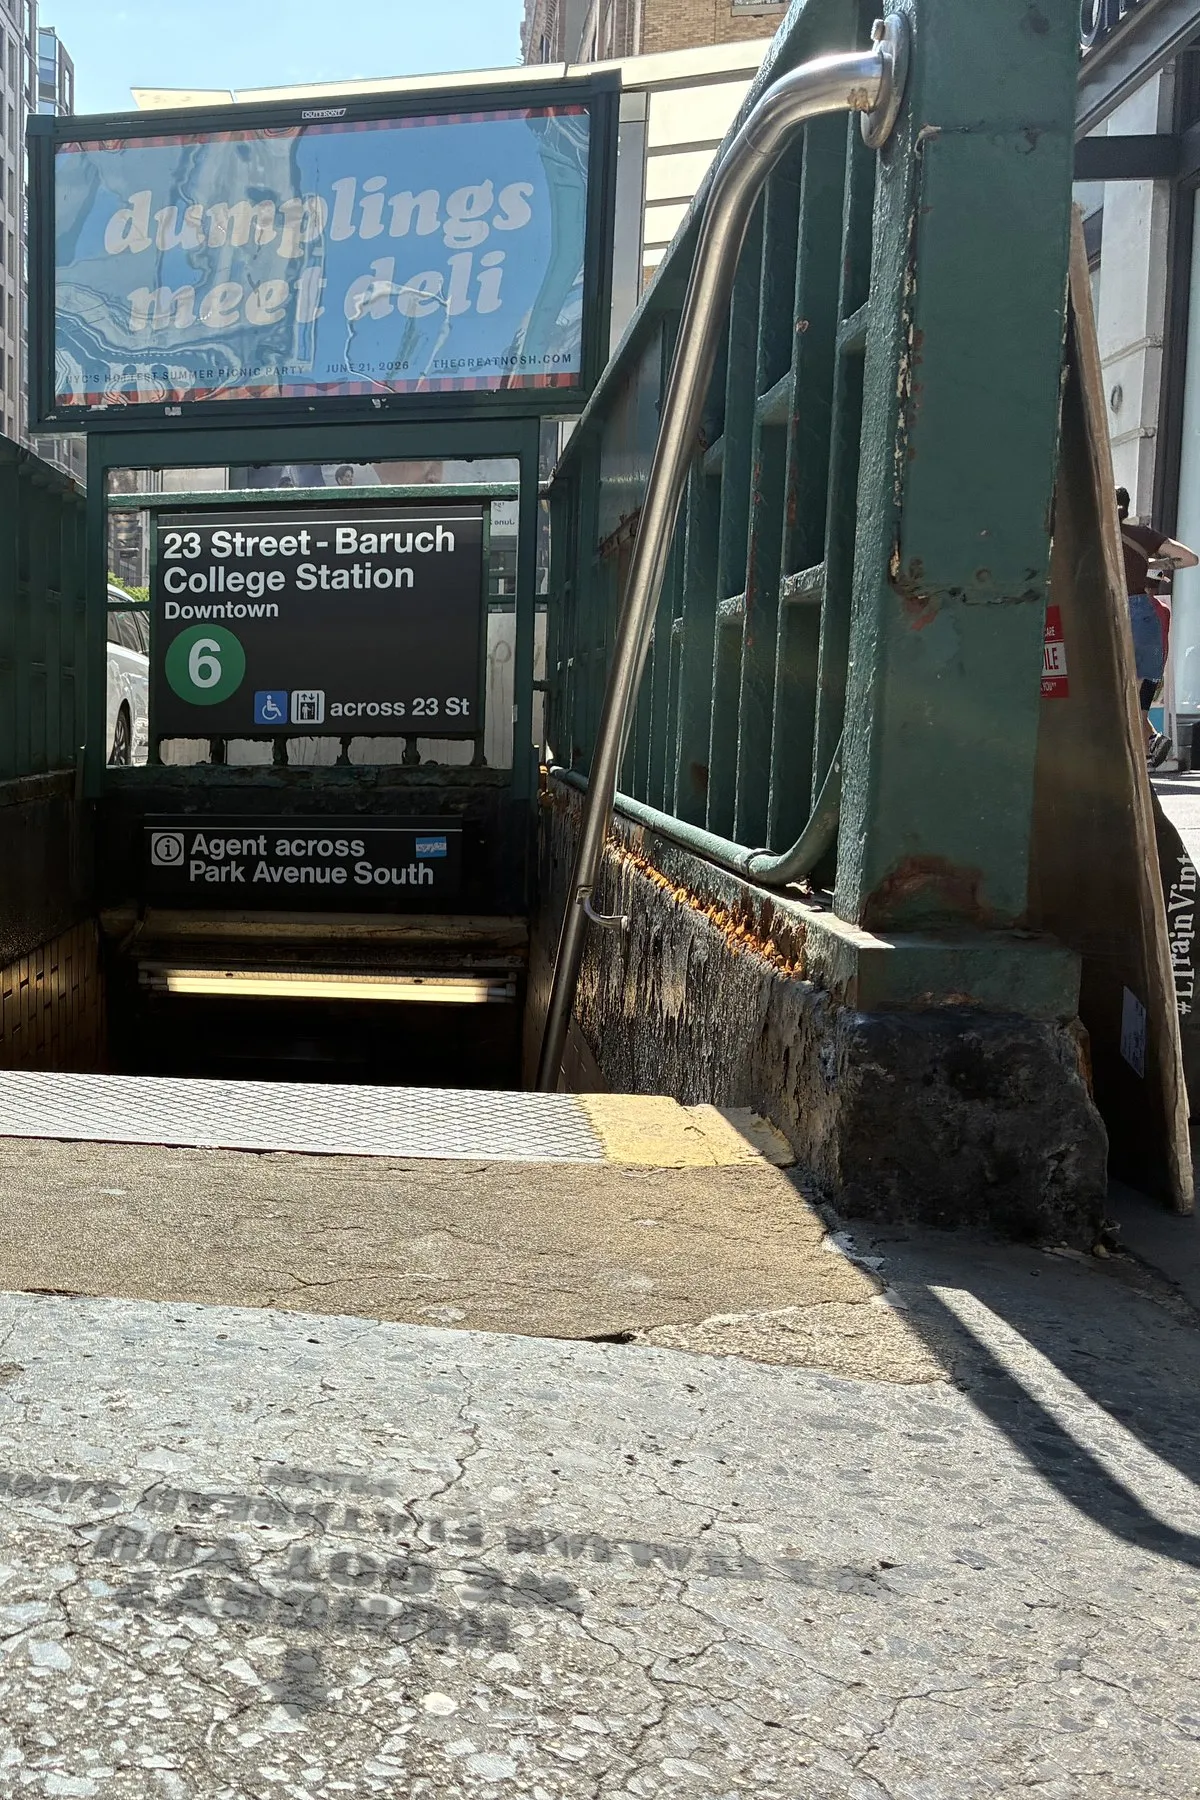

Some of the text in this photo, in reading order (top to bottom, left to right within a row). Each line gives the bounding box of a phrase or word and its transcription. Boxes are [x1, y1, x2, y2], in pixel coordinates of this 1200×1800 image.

[104, 176, 534, 258] dumplings
[127, 252, 505, 332] meet deli
[65, 353, 572, 384] NYC'S HOTTEST SUMMER PICNIC PARTY JUNE 21, 2026 THEGREATNOSH.COM
[163, 532, 202, 560] 23
[163, 562, 415, 598] College Station
[164, 600, 279, 620] Downtown
[187, 638, 222, 689] 6
[330, 696, 470, 717] across 23 St
[190, 833, 365, 859] Agent across
[189, 859, 434, 885] Park Avenue South
